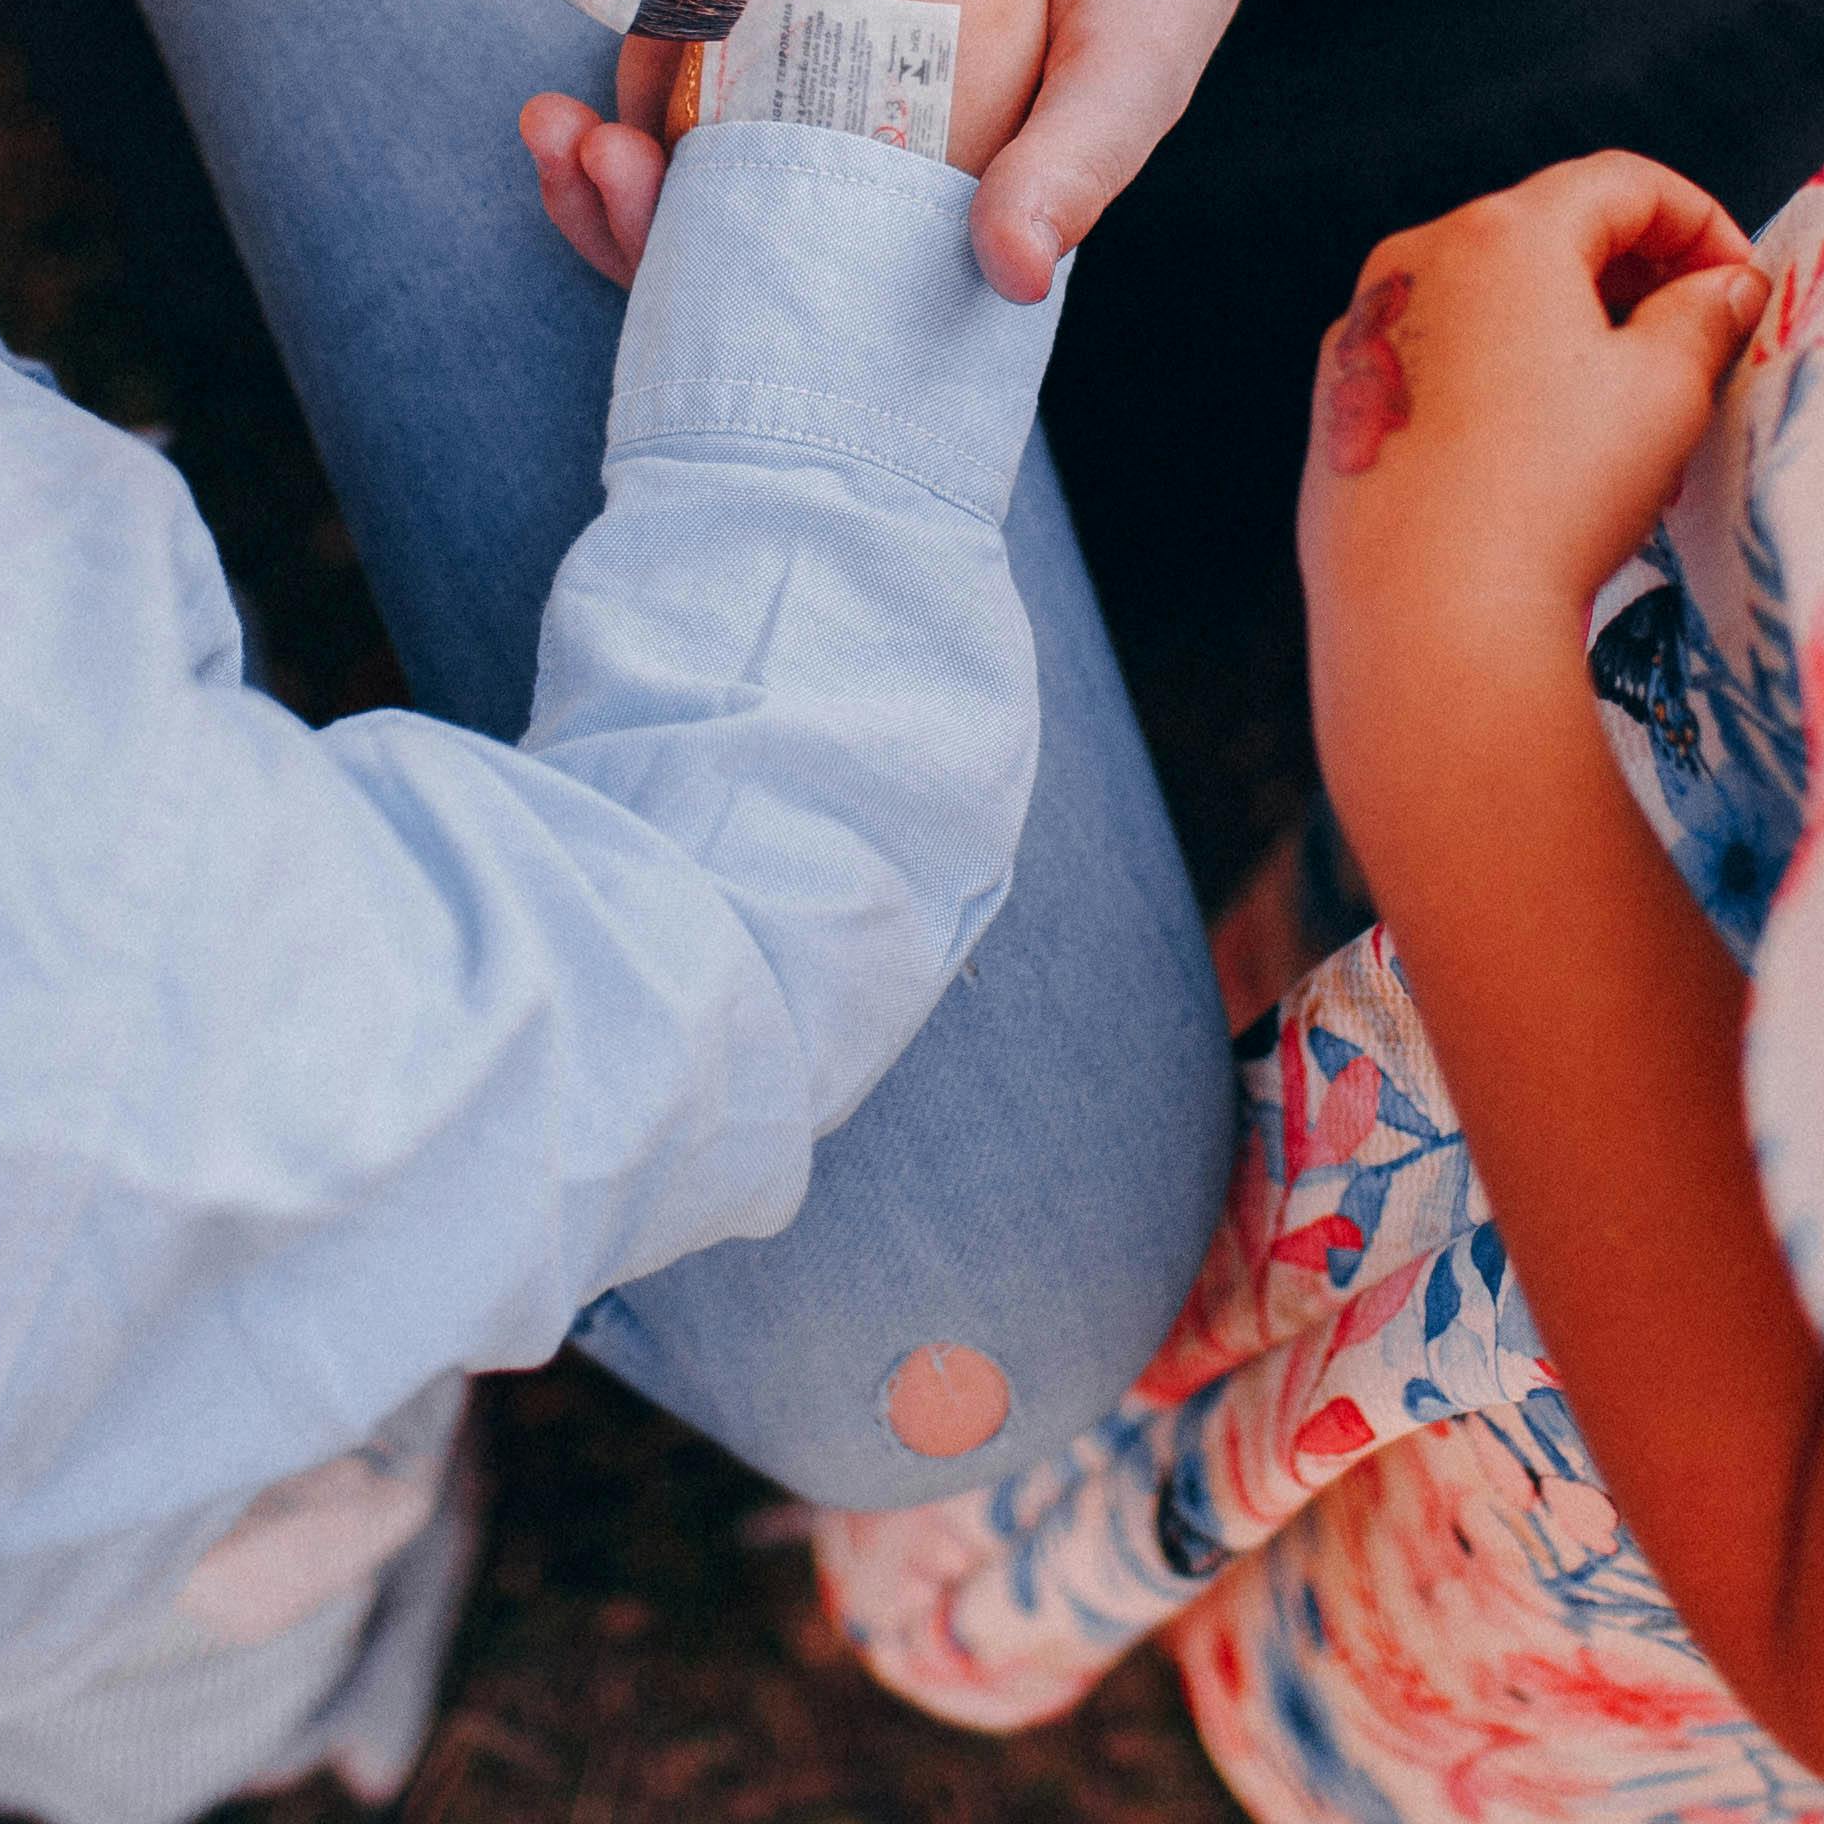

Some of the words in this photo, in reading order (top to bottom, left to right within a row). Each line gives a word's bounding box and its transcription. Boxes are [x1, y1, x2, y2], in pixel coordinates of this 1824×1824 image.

[776, 2, 792, 83] TEMPORÁRIA
[821, 31, 832, 60] verso
[830, 21, 842, 73] segundos
[883, 99, 901, 121] +3
